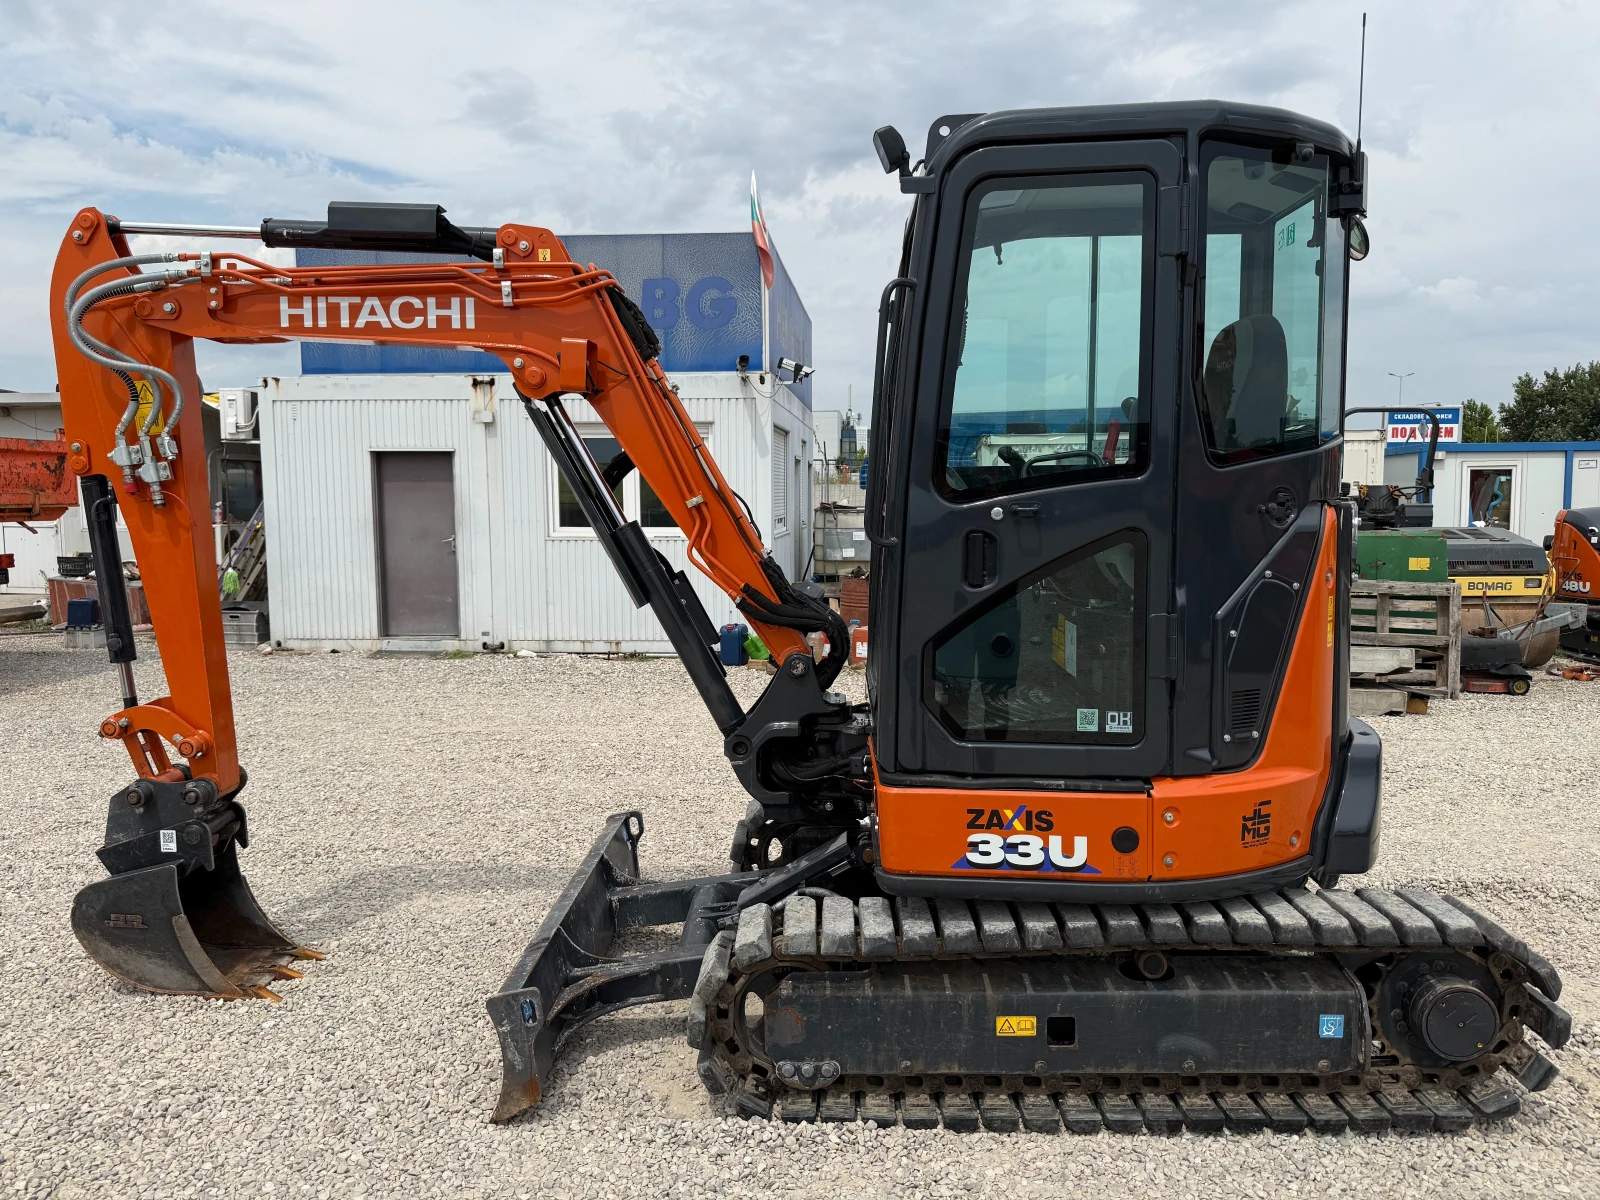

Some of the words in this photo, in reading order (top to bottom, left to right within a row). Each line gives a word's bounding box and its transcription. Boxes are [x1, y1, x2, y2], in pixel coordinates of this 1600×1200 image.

[279, 296, 476, 329] HITACHI
[640, 276, 737, 330] BG
[1391, 427, 1417, 440] ПОД
[1467, 581, 1513, 591] BOMAG
[1561, 580, 1591, 593] 48U
[966, 804, 1055, 832] ZAXIS
[965, 833, 1088, 871] 33U
